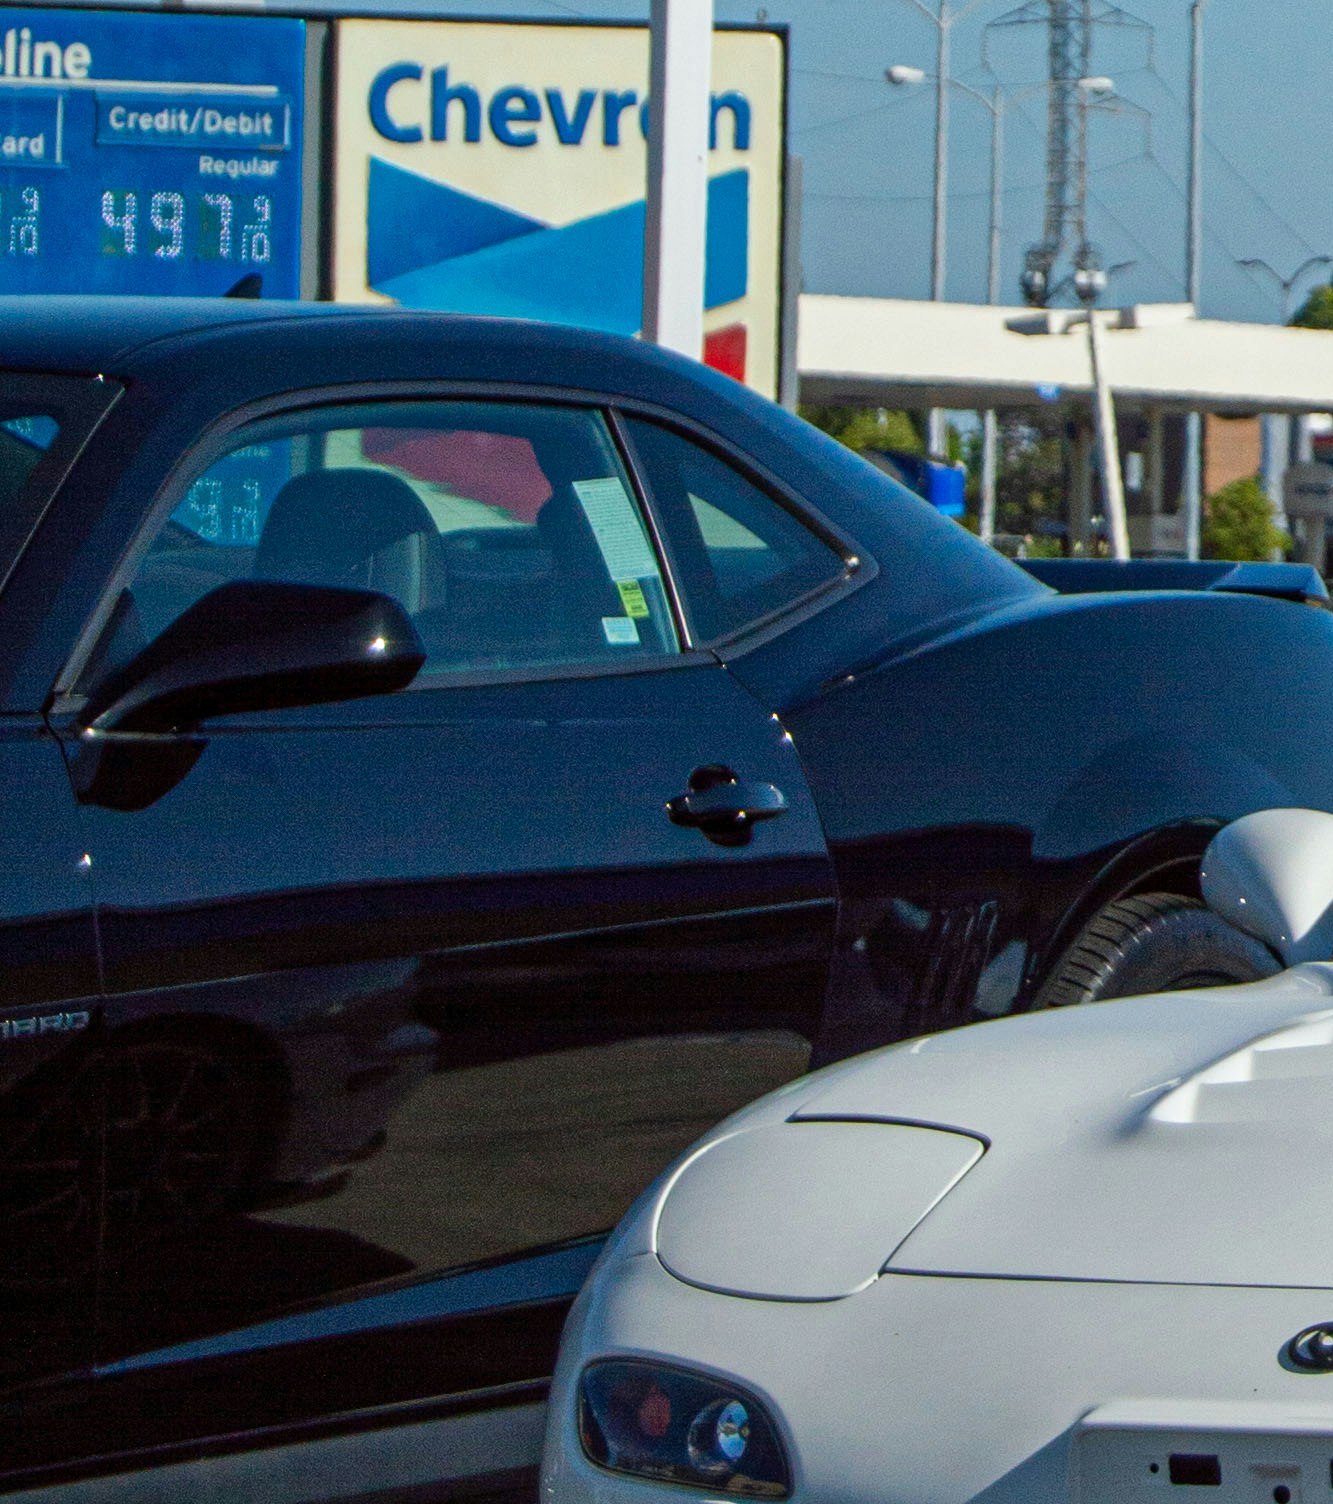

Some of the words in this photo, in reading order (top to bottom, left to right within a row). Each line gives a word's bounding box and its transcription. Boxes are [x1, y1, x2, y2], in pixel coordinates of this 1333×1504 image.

[0, 27, 91, 79] line
[108, 104, 273, 137] Credit/Debit
[368, 60, 752, 152] Chevrn
[199, 154, 279, 178] Regular
